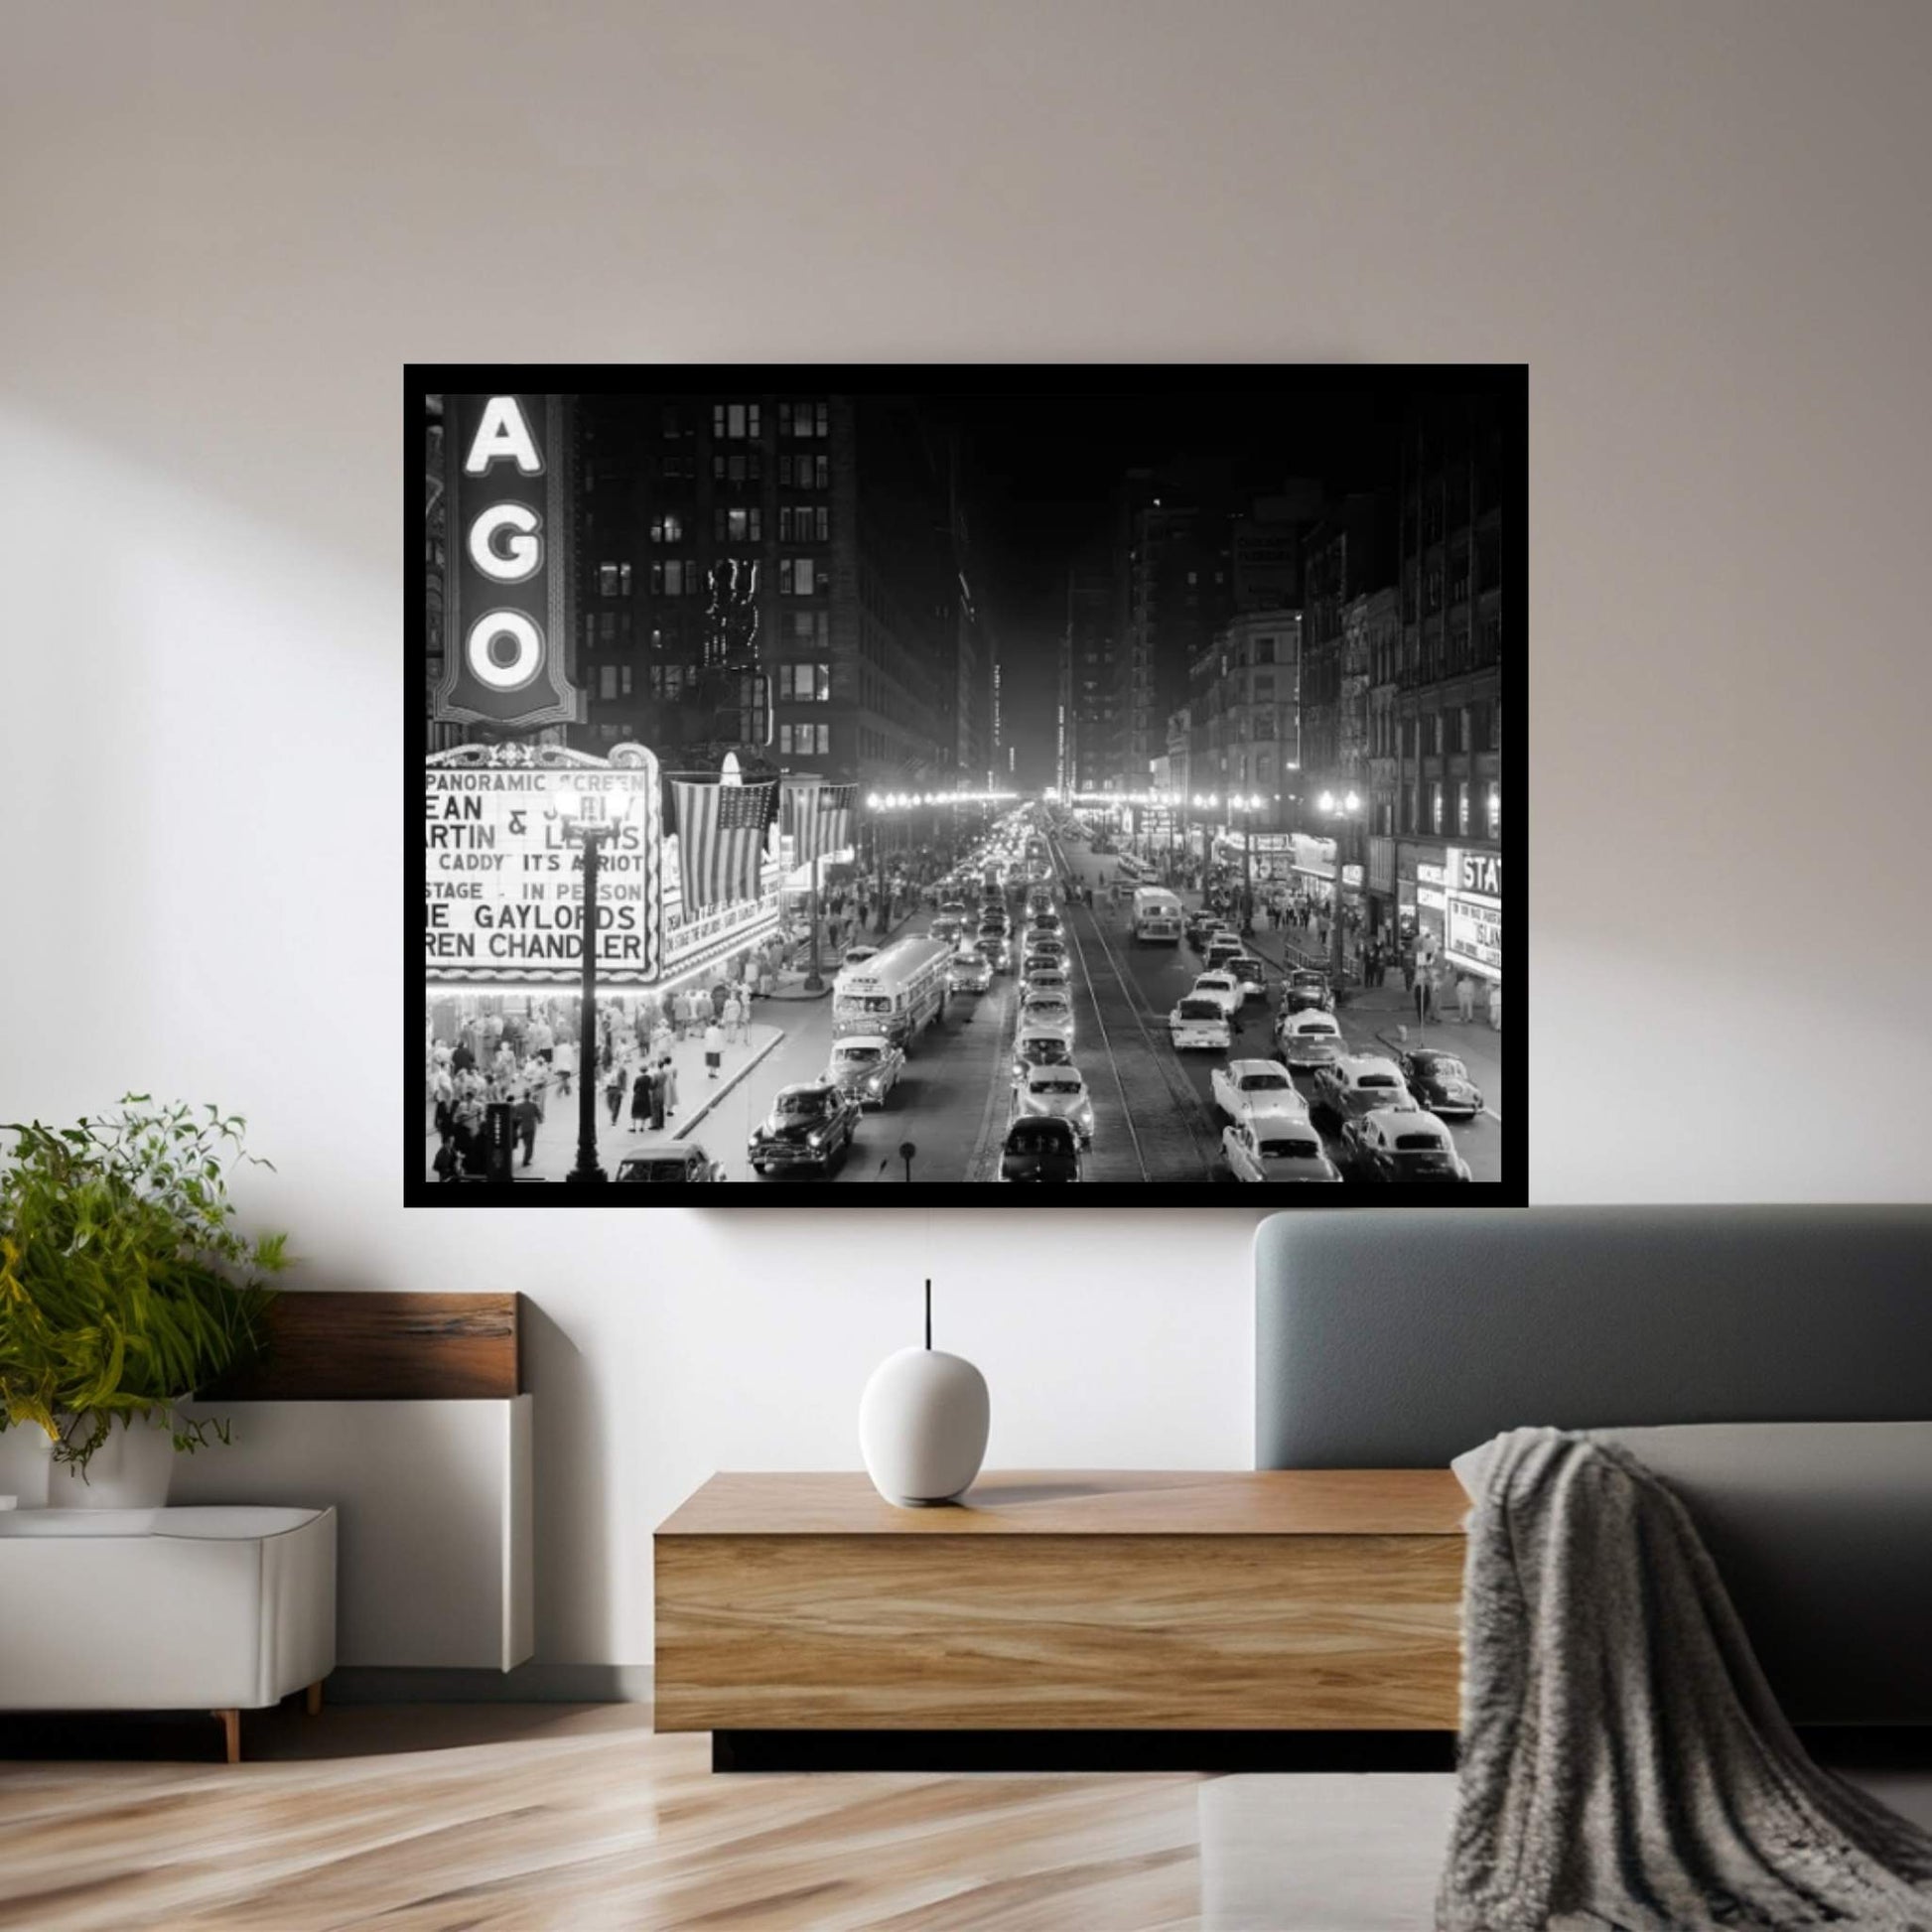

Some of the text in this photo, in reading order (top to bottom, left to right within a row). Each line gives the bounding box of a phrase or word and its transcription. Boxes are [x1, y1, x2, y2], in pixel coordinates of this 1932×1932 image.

[466, 396, 542, 687] AGO
[426, 773, 546, 791] PANORAMIC
[426, 795, 482, 820] EAN
[508, 810, 527, 835] &
[426, 824, 639, 850] RTIN LEIS
[596, 855, 643, 872] RIOT
[1463, 855, 1501, 893] STA
[522, 883, 544, 900] IN
[556, 884, 642, 900] PESON
[426, 902, 449, 928] E
[426, 932, 475, 957] REN
